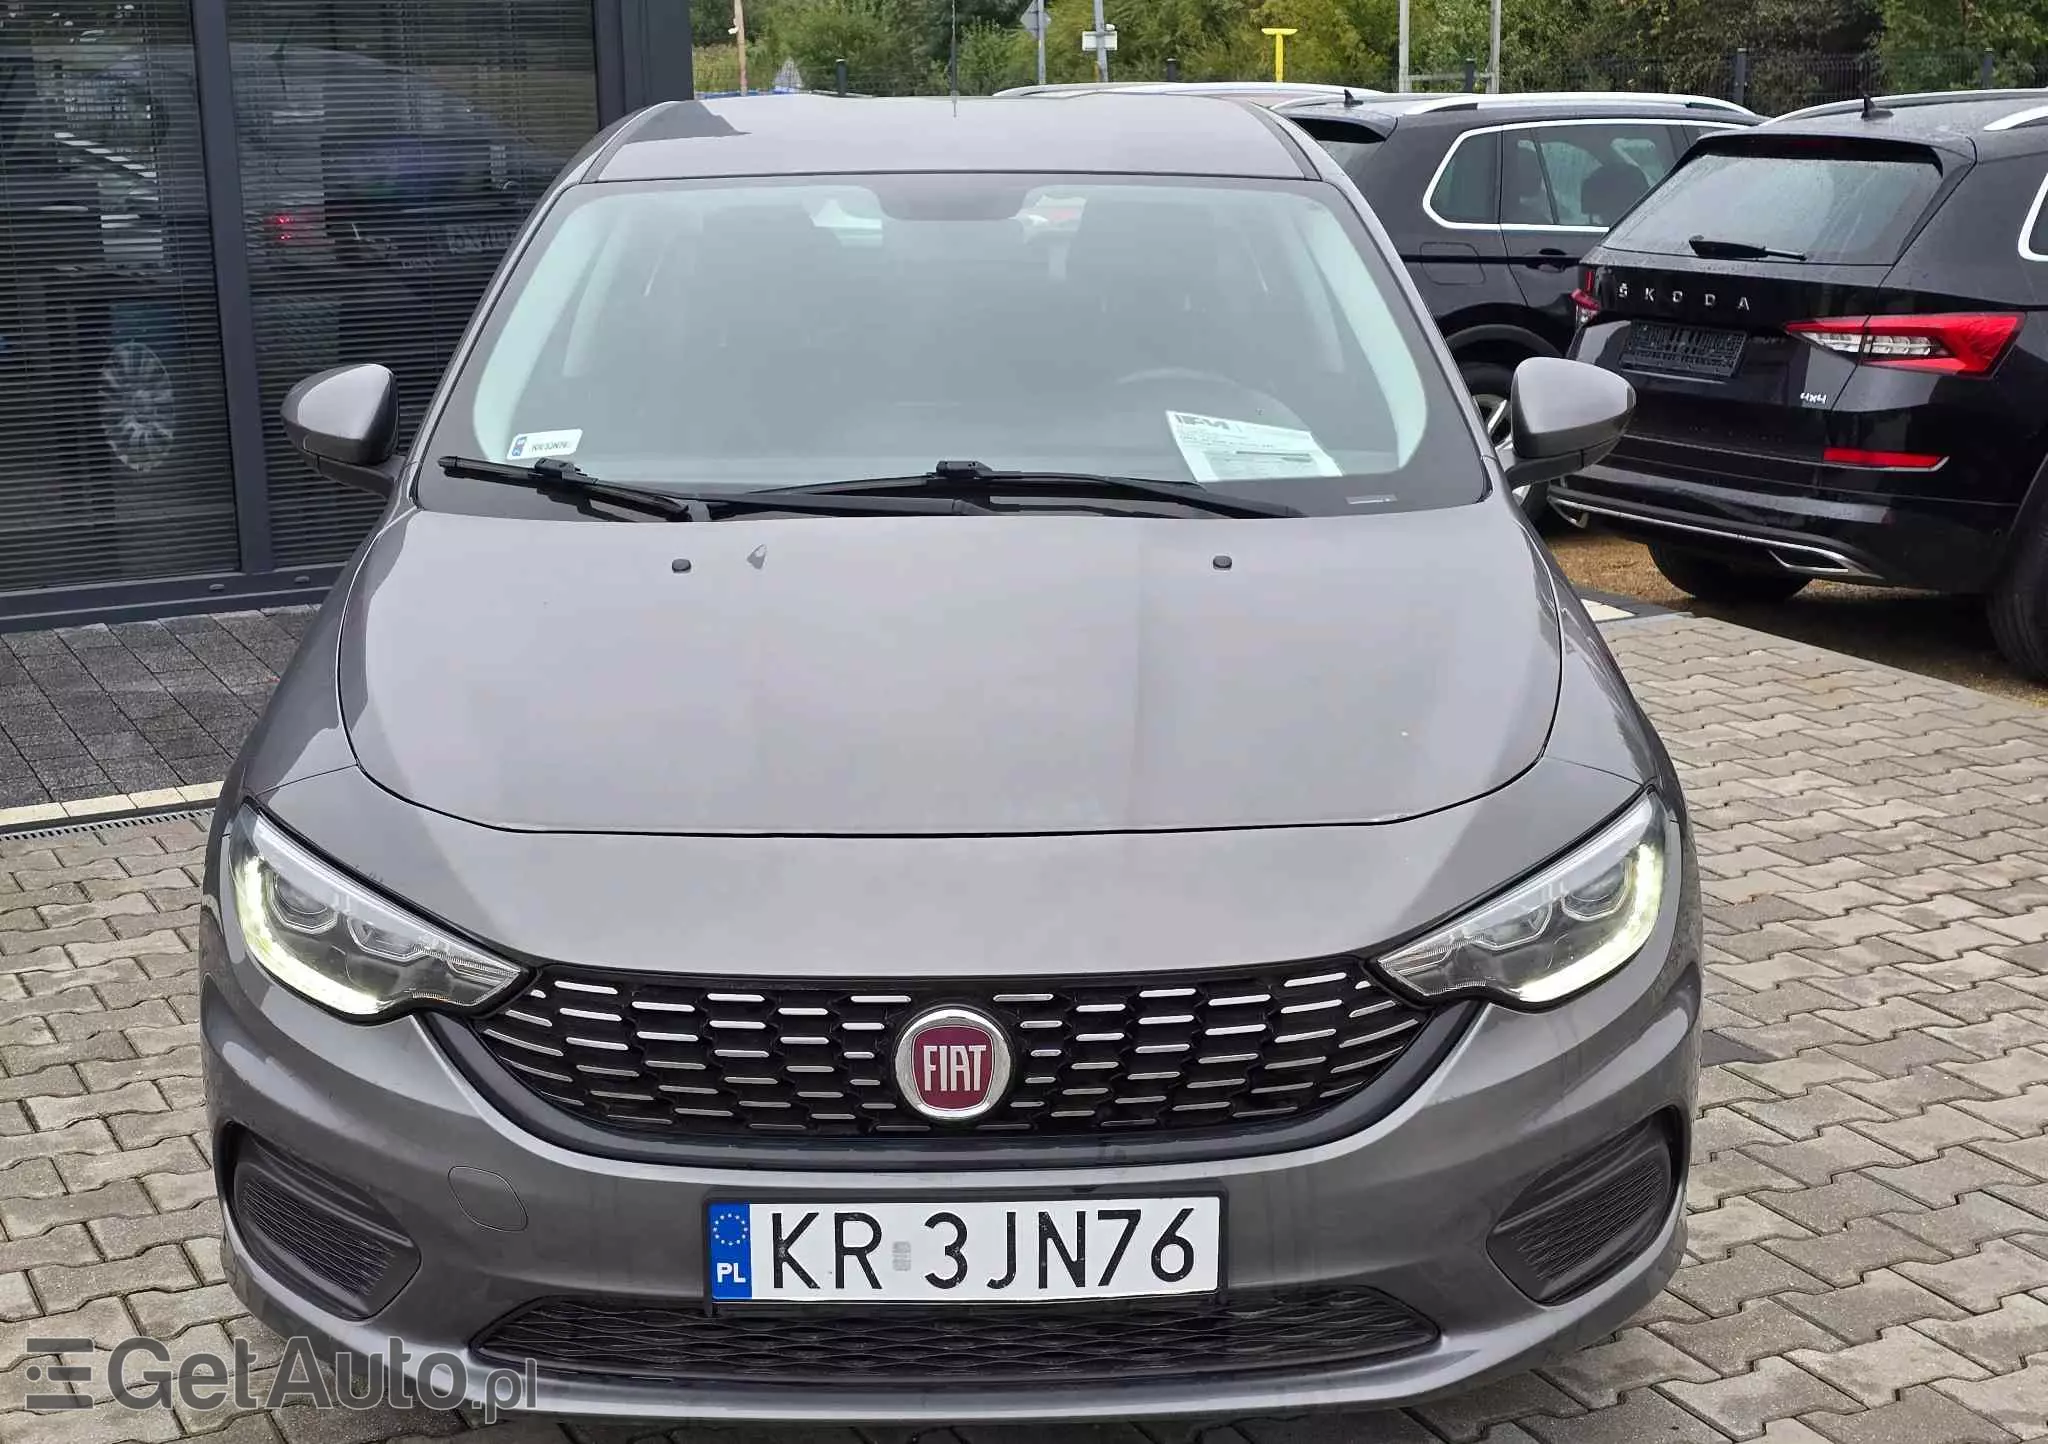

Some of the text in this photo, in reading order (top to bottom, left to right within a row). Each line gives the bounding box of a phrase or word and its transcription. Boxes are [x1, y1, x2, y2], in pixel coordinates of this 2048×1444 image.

[922, 1044, 987, 1093] FIAT
[771, 1207, 1195, 1290] KR 3JN76
[717, 1263, 746, 1284] PL
